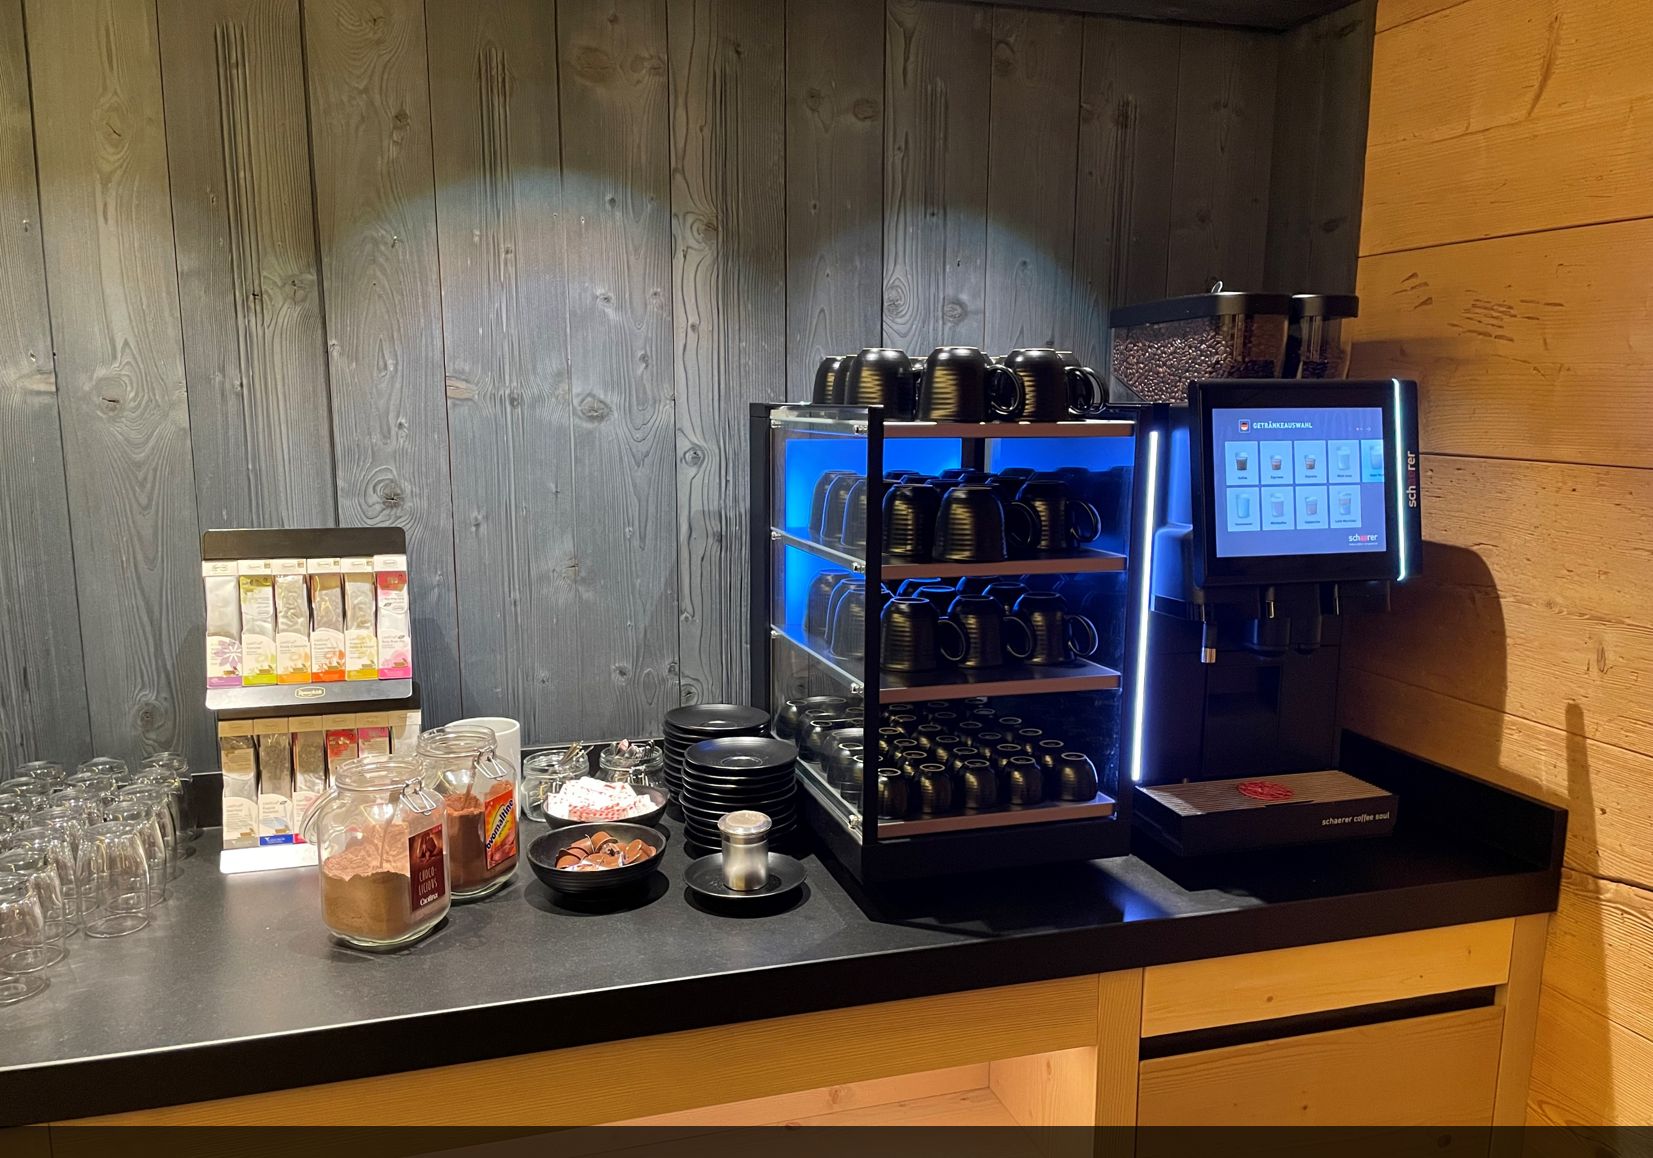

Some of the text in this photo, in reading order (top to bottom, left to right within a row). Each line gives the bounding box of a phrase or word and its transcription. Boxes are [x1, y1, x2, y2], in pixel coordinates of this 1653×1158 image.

[1252, 420, 1313, 430] GETRÄNKEAUSWAHL
[1321, 811, 1390, 825] schaerer coffee soul
